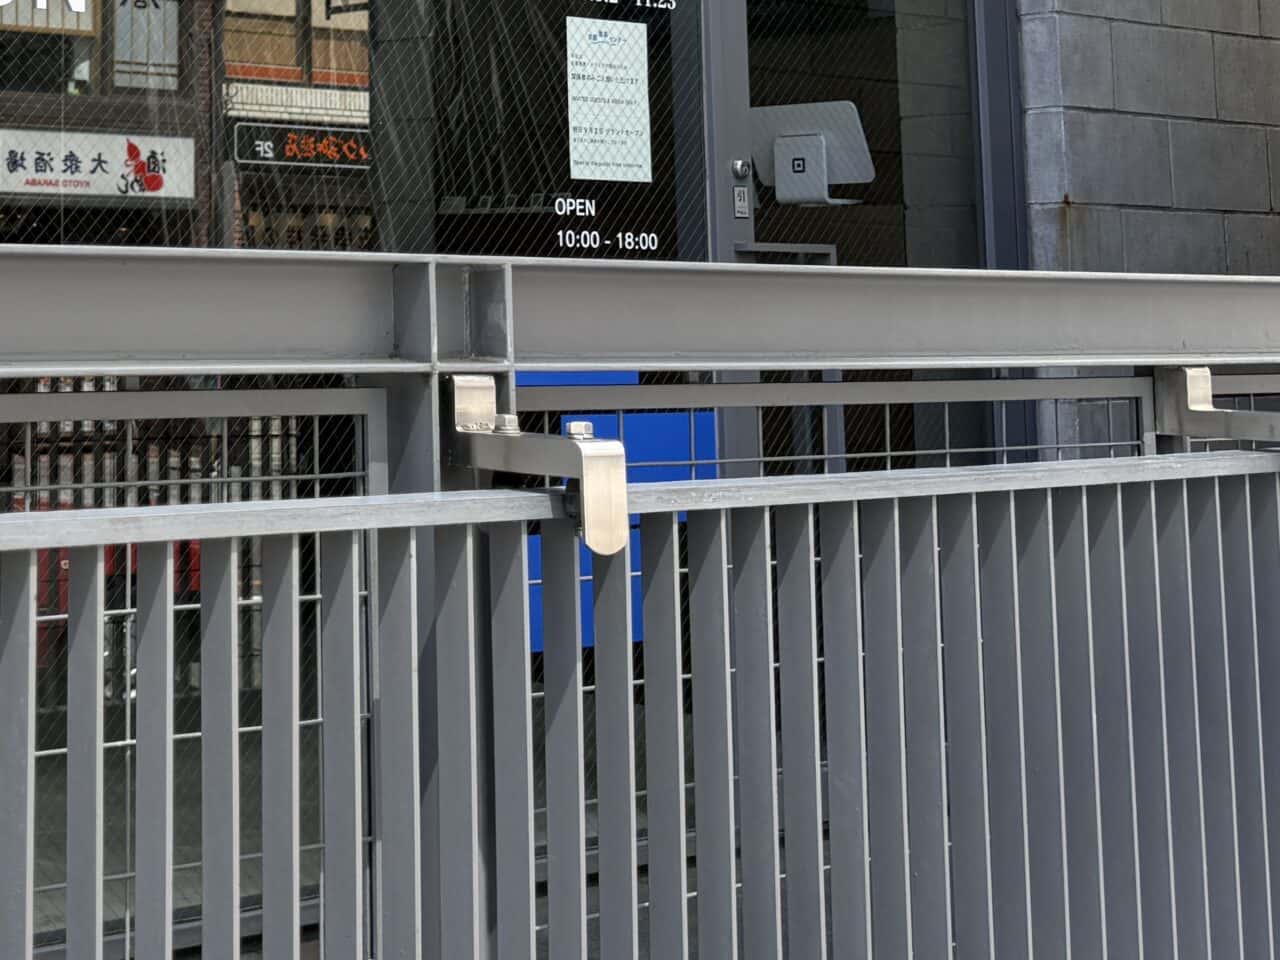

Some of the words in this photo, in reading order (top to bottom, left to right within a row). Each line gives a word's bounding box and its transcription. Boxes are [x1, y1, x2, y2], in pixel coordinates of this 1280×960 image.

[554, 197, 596, 217] OPEN
[557, 229, 600, 249] 10:00
[616, 231, 658, 250] 18:00
